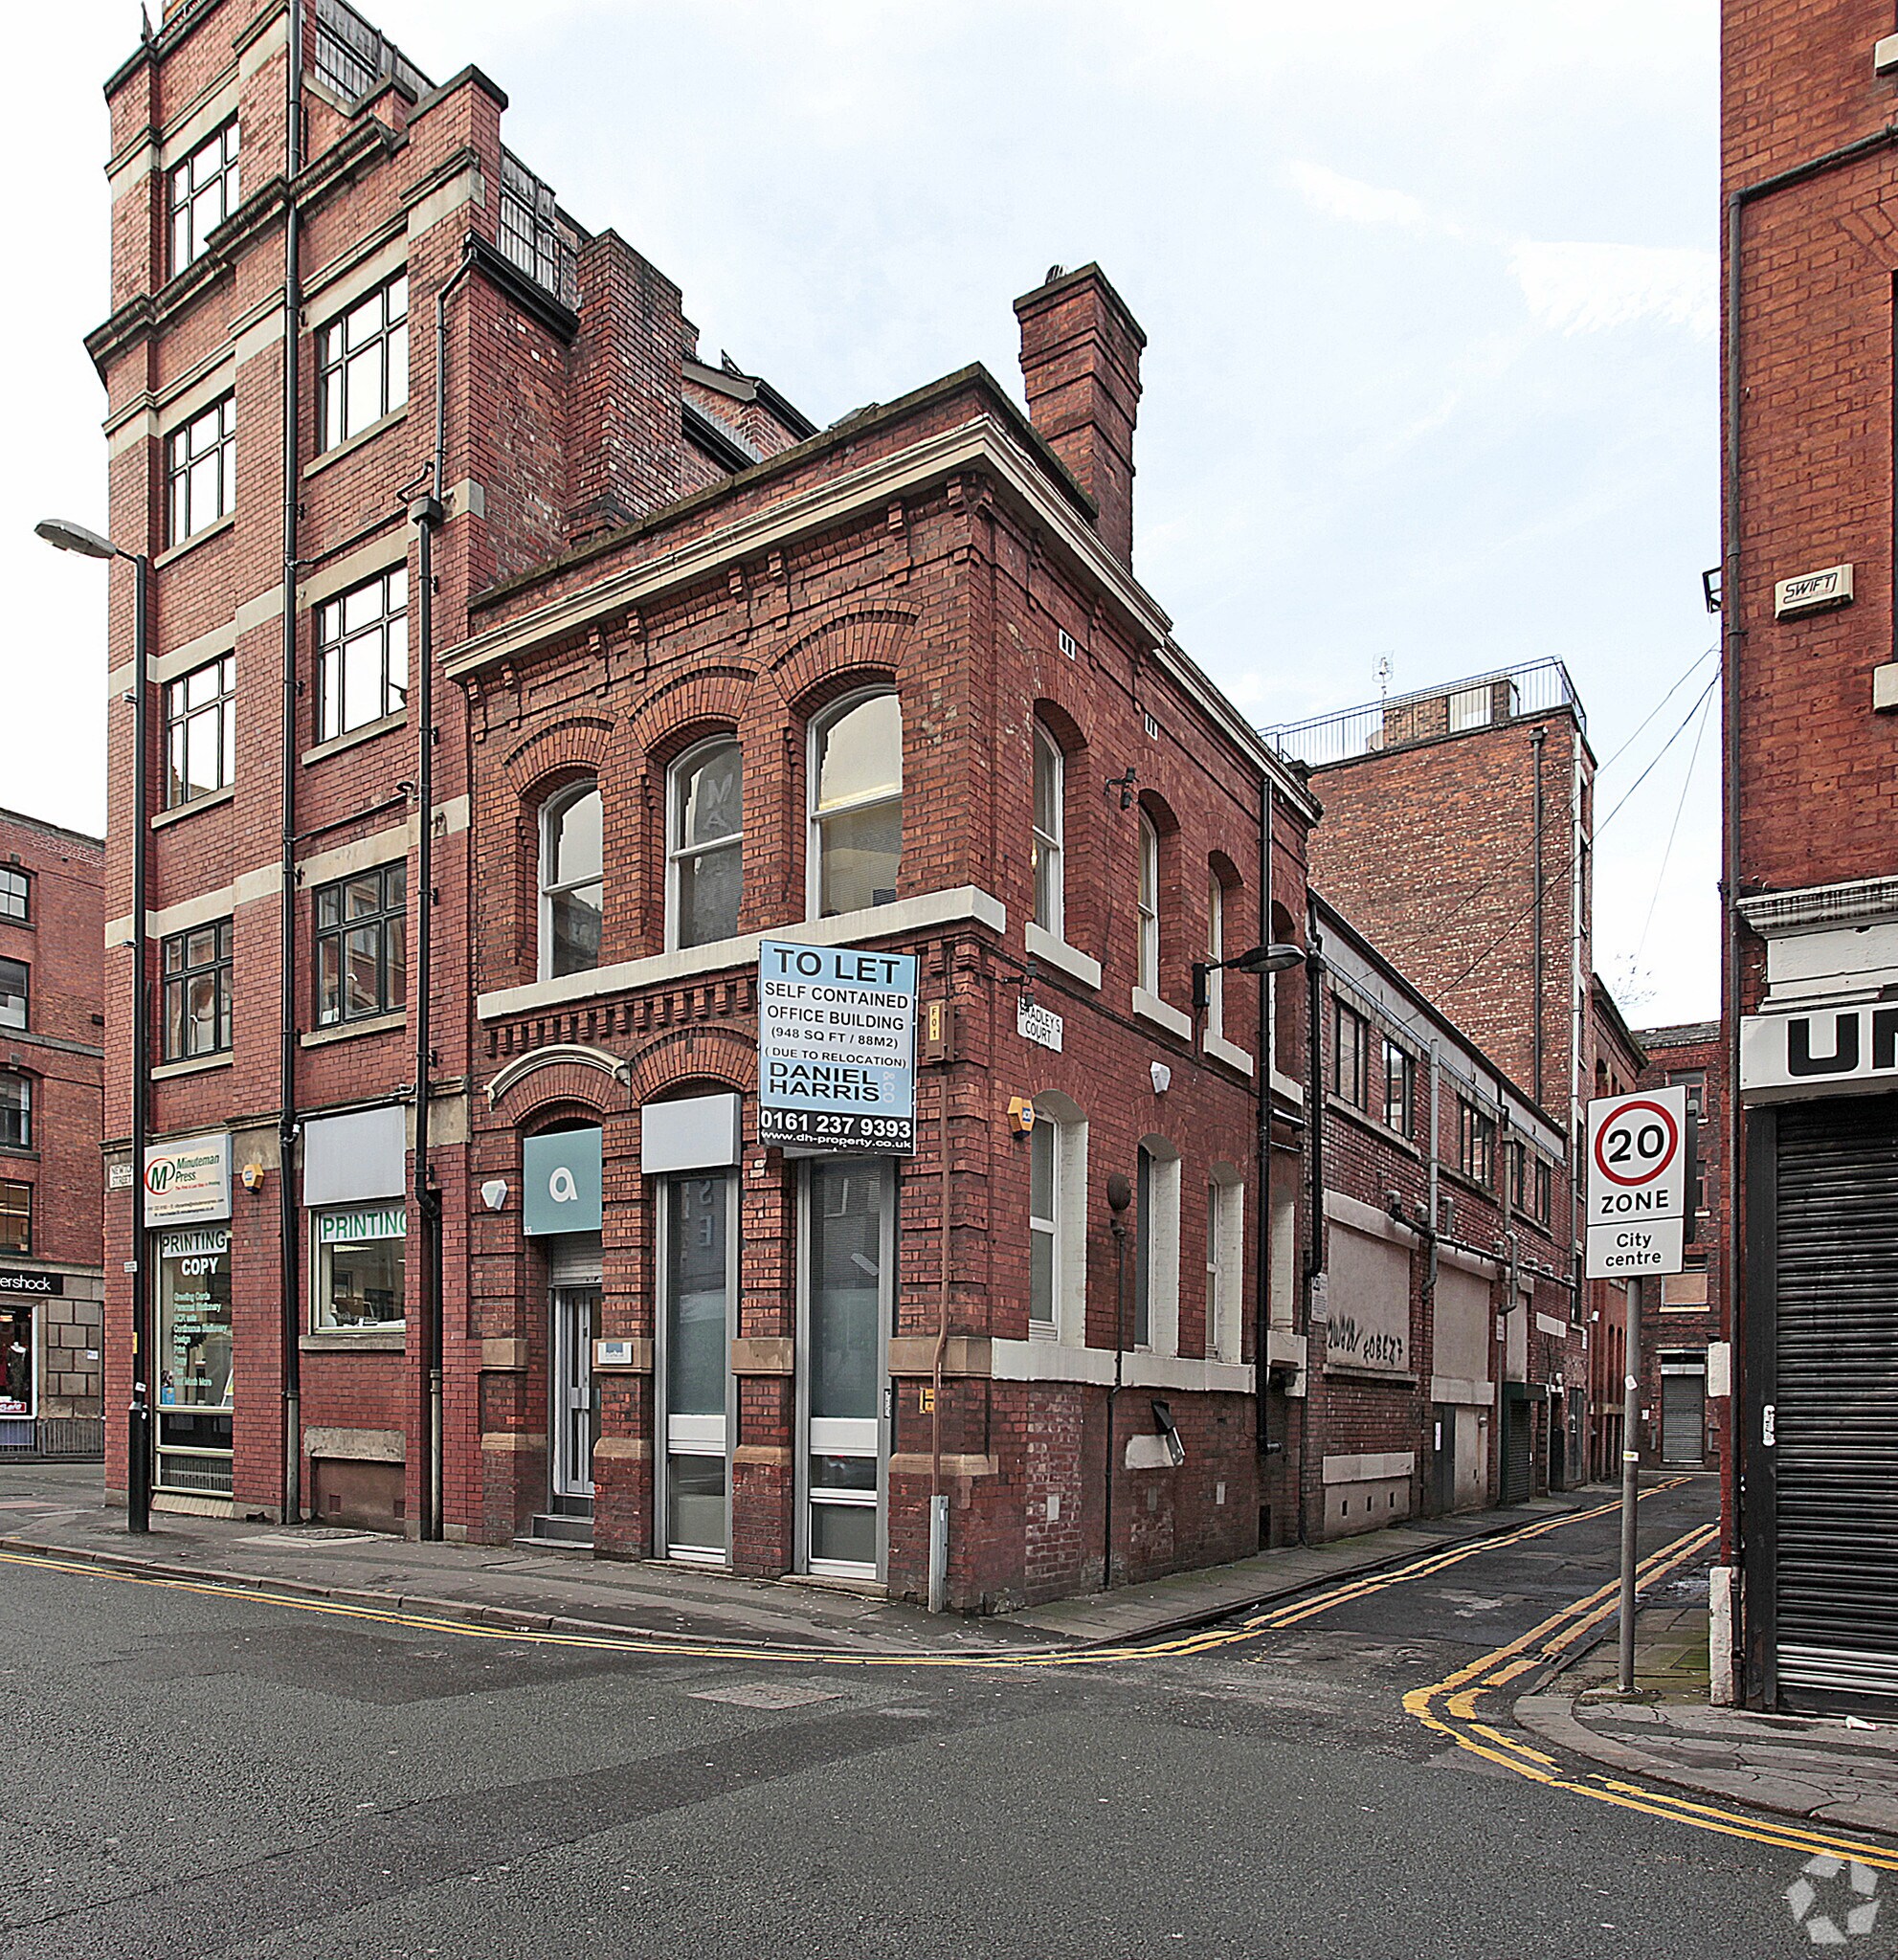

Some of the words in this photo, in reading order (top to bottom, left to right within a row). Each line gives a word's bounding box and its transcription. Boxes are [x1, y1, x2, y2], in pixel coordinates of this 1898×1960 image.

[1783, 572, 1838, 604] SWIFT
[773, 947, 822, 976] TO
[835, 955, 901, 984] LET
[765, 982, 806, 998] SELF
[812, 987, 908, 1009] CONTAINED
[768, 1005, 824, 1023] OFFICE
[829, 1012, 904, 1031] BUILDING
[771, 1027, 800, 1038] (948
[804, 1030, 825, 1042] SQ
[829, 1032, 846, 1043] FT
[850, 1035, 855, 1044] /
[858, 1036, 899, 1049] 88M2)
[1025, 1020, 1052, 1043] COURT
[772, 1047, 798, 1058] DUE
[802, 1050, 818, 1060] TO
[821, 1052, 906, 1069] RELOCATION)
[770, 1061, 879, 1085] DANIEL
[770, 1079, 880, 1102] HARRIS
[760, 1110, 808, 1131] 0161
[815, 1115, 855, 1135] 237
[860, 1118, 911, 1139] 9393
[760, 1129, 912, 1148] www.dh-property.co.uk
[1607, 1125, 1664, 1164] 20
[112, 1164, 133, 1175] NEWTO
[177, 1154, 220, 1169] Minuteman
[112, 1174, 132, 1186] STREET
[175, 1170, 196, 1183] Press
[548, 1167, 578, 1203] a
[1601, 1189, 1668, 1214] ZONE
[162, 1231, 226, 1253] PRINTING
[1616, 1232, 1652, 1249] City
[182, 1257, 219, 1276] COPY
[1605, 1250, 1662, 1267] centre
[0, 1275, 51, 1290] ershock
